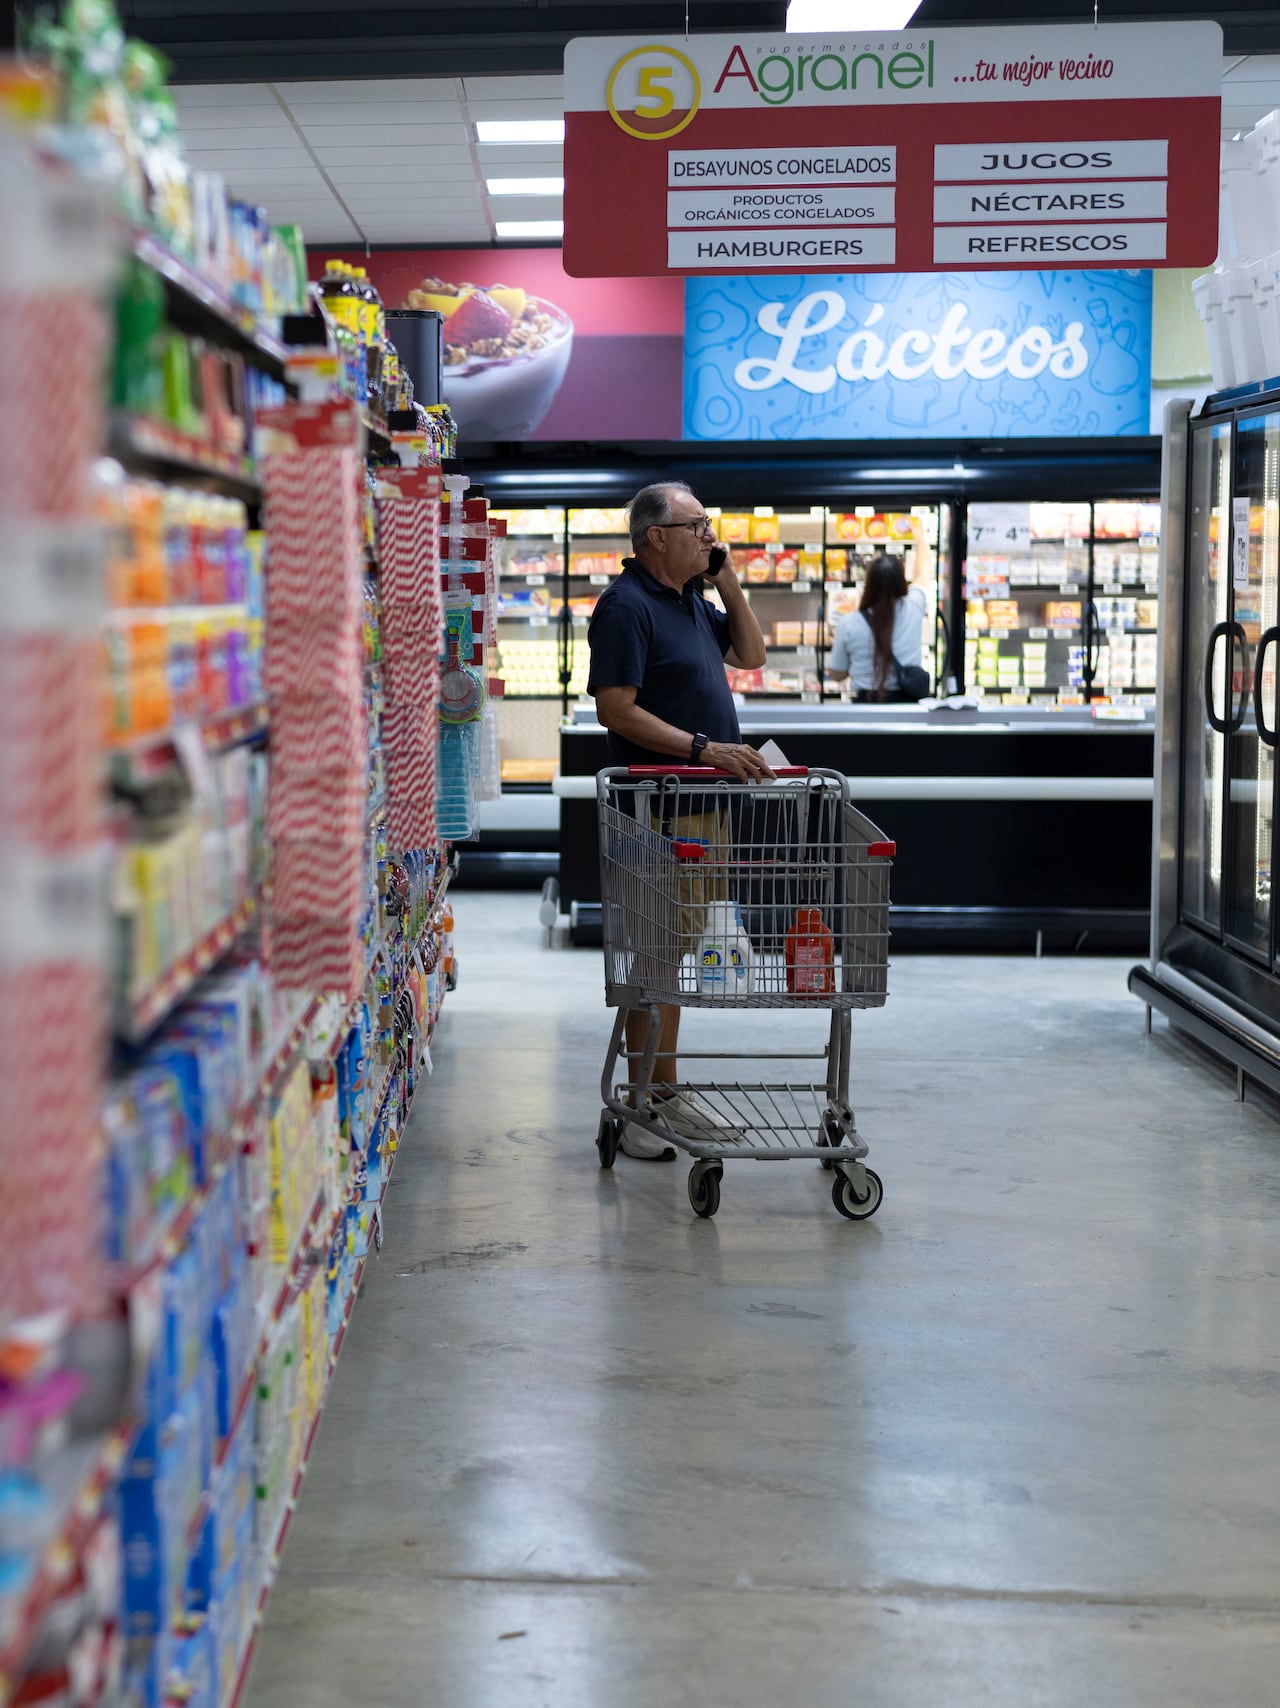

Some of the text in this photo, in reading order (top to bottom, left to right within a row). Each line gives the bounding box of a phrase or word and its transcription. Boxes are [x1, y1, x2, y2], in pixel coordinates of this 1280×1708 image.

[756, 41, 927, 54] supermercados
[713, 39, 935, 105] Agranel
[1003, 54, 1054, 87] mejor
[1059, 53, 1114, 81] vecino
[634, 66, 675, 118] 5
[674, 157, 891, 177] DESAYUNOS CONGELADOS
[981, 152, 1113, 170] JUGOS
[733, 194, 823, 206] PRODUCTOS
[971, 192, 1126, 212] NÉCTARES
[684, 206, 876, 221] ORGÁNICOS CONGELADOS
[697, 239, 863, 258] HAMBURGERS
[968, 235, 1128, 253] REFRESCOS
[734, 291, 1088, 394] Lácteos
[703, 953, 718, 965] all
